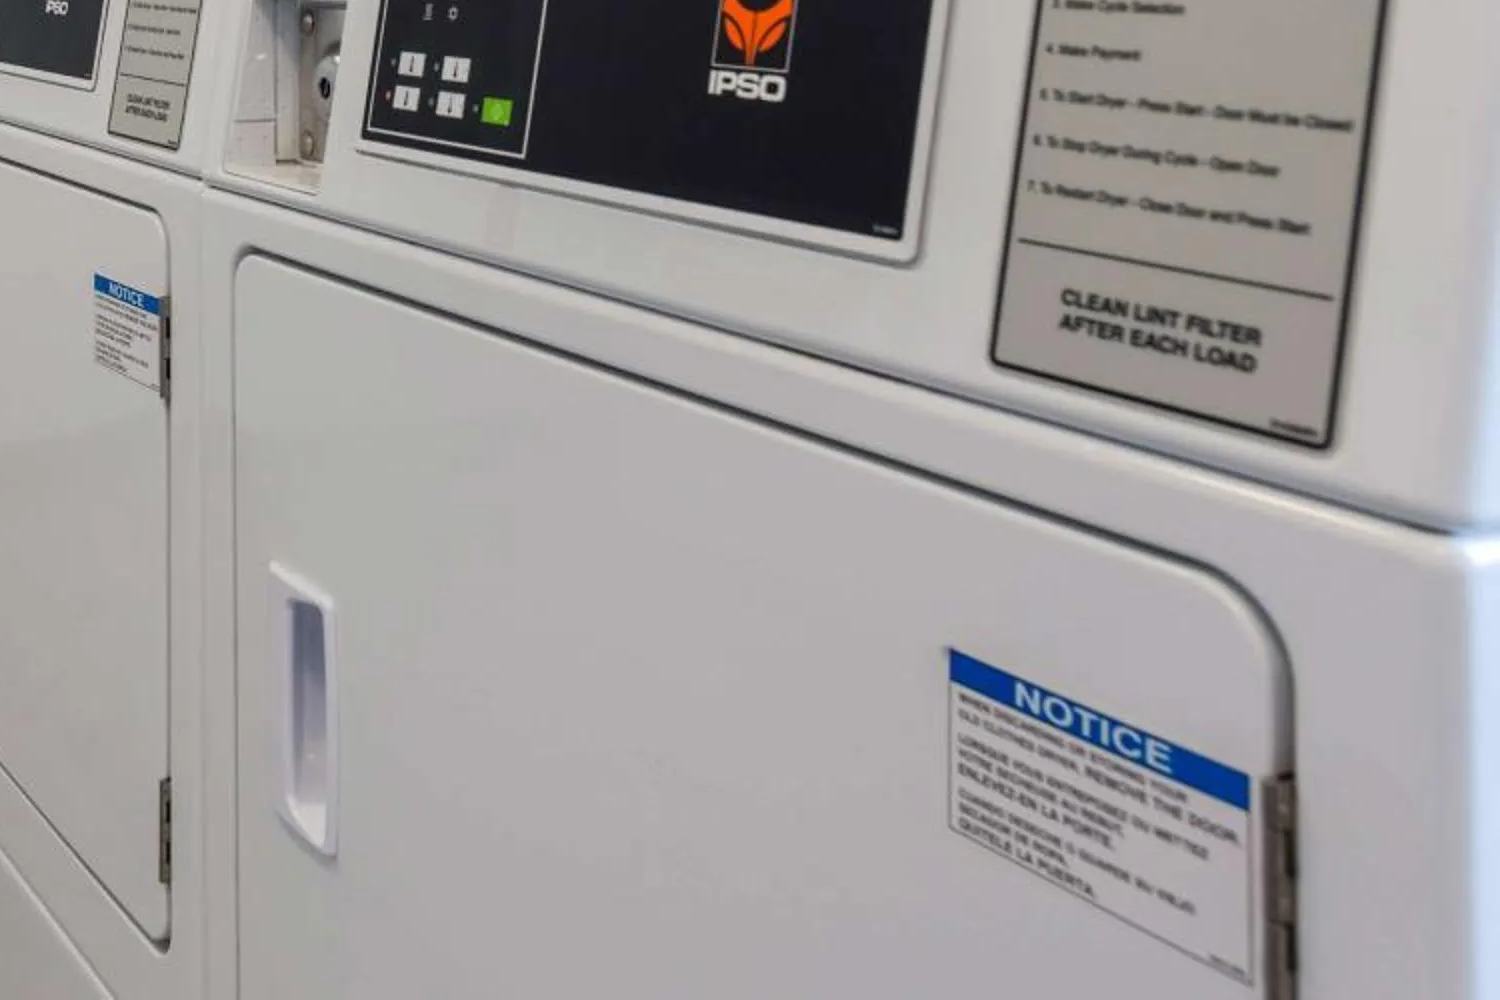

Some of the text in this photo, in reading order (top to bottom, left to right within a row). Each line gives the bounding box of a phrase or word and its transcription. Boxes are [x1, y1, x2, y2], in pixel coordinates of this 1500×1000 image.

[1130, 1, 1186, 15] Selection
[1058, 44, 1088, 56] Make
[1090, 45, 1142, 63] Payment
[708, 69, 787, 102] IPSO
[1059, 287, 1263, 347] CLEAN LINT FILTER
[1057, 312, 1258, 375] AFTER EACH LOAD
[1014, 679, 1172, 776] NOTICE
